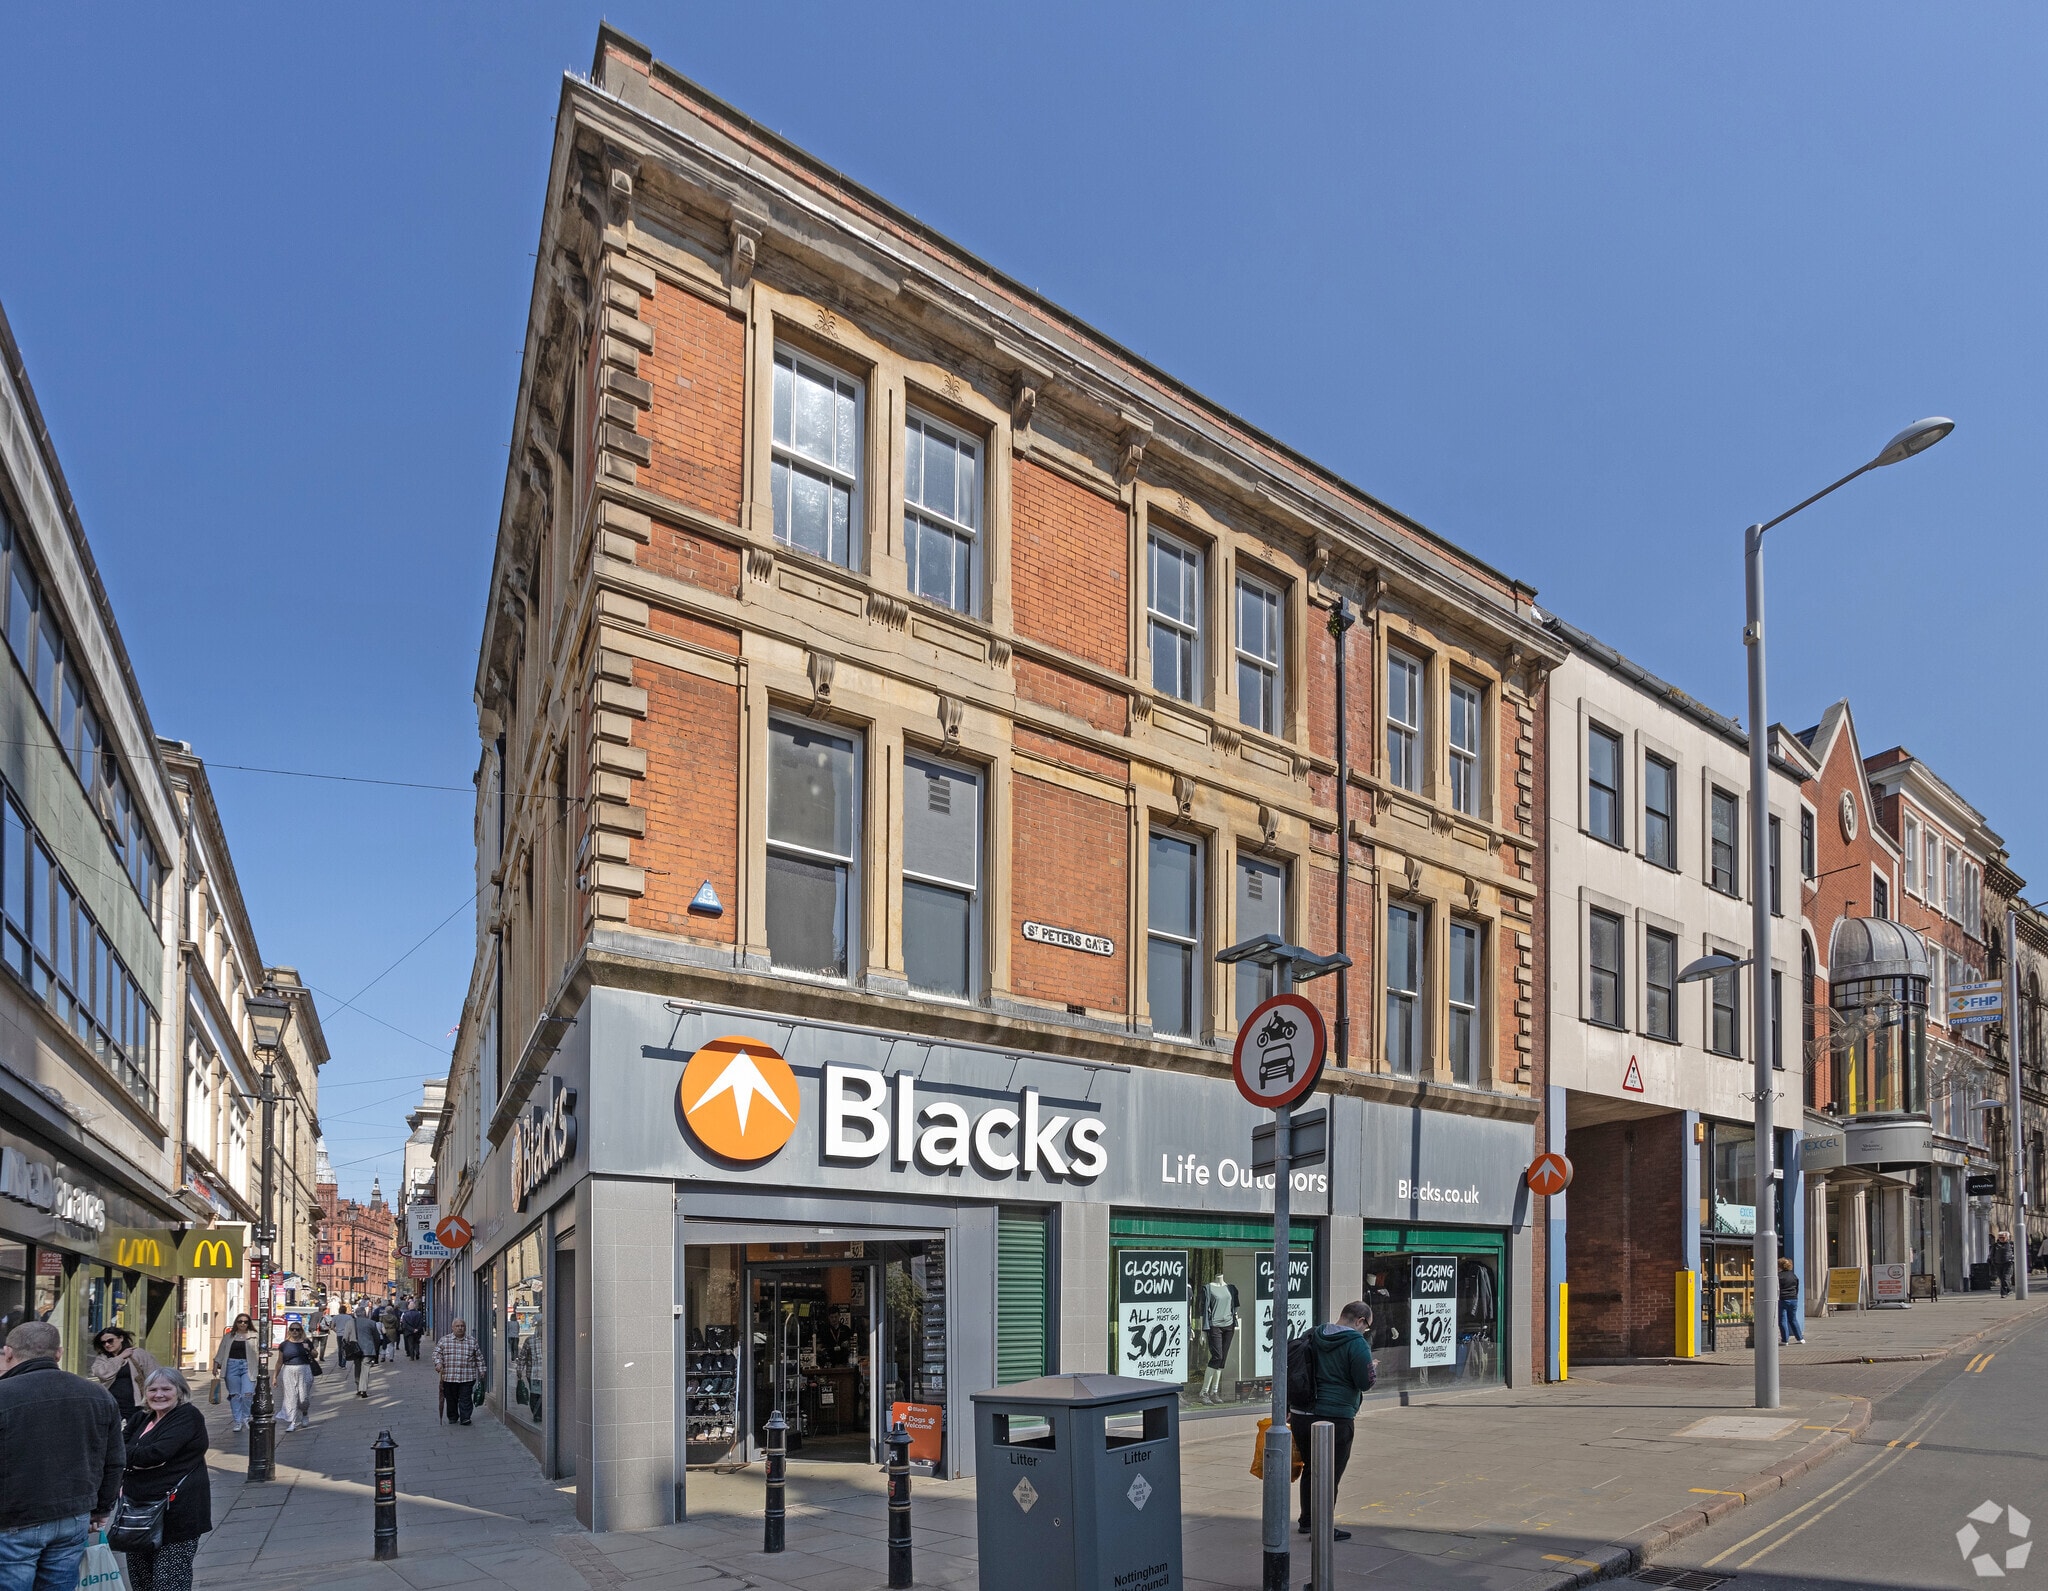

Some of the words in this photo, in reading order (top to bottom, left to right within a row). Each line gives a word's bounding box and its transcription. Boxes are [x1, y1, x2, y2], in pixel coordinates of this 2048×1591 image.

[1042, 928, 1081, 946] PETERS
[1085, 938, 1110, 952] GATE
[1971, 996, 1998, 1007] FHP
[825, 1061, 1107, 1177] Blacks
[1805, 1138, 1839, 1150] EXCEL
[1162, 1154, 1209, 1185] Life
[1218, 1158, 1327, 1193] Outors
[1399, 1180, 1479, 1204] Blacks.co.uk
[1125, 1260, 1184, 1277] CLOSING
[1260, 1261, 1309, 1276] CLING
[1416, 1264, 1454, 1278] CLOSING
[1134, 1279, 1174, 1295] DOWN
[1421, 1279, 1447, 1292] DOWN
[1129, 1309, 1154, 1324] ALL
[1418, 1304, 1434, 1316] ALL
[1416, 1316, 1451, 1346] 30%
[1127, 1324, 1180, 1361] 30%
[1441, 1336, 1451, 1344] OFF
[1164, 1348, 1181, 1357] OFF
[1138, 1360, 1174, 1368] ABSOLUTELY
[1139, 1368, 1173, 1376] EVERYTHING
[1010, 1453, 1038, 1467] Litter
[1124, 1450, 1151, 1465] Litter
[1115, 1562, 1168, 1587] Nottingham
[1134, 1573, 1169, 1591] Council
